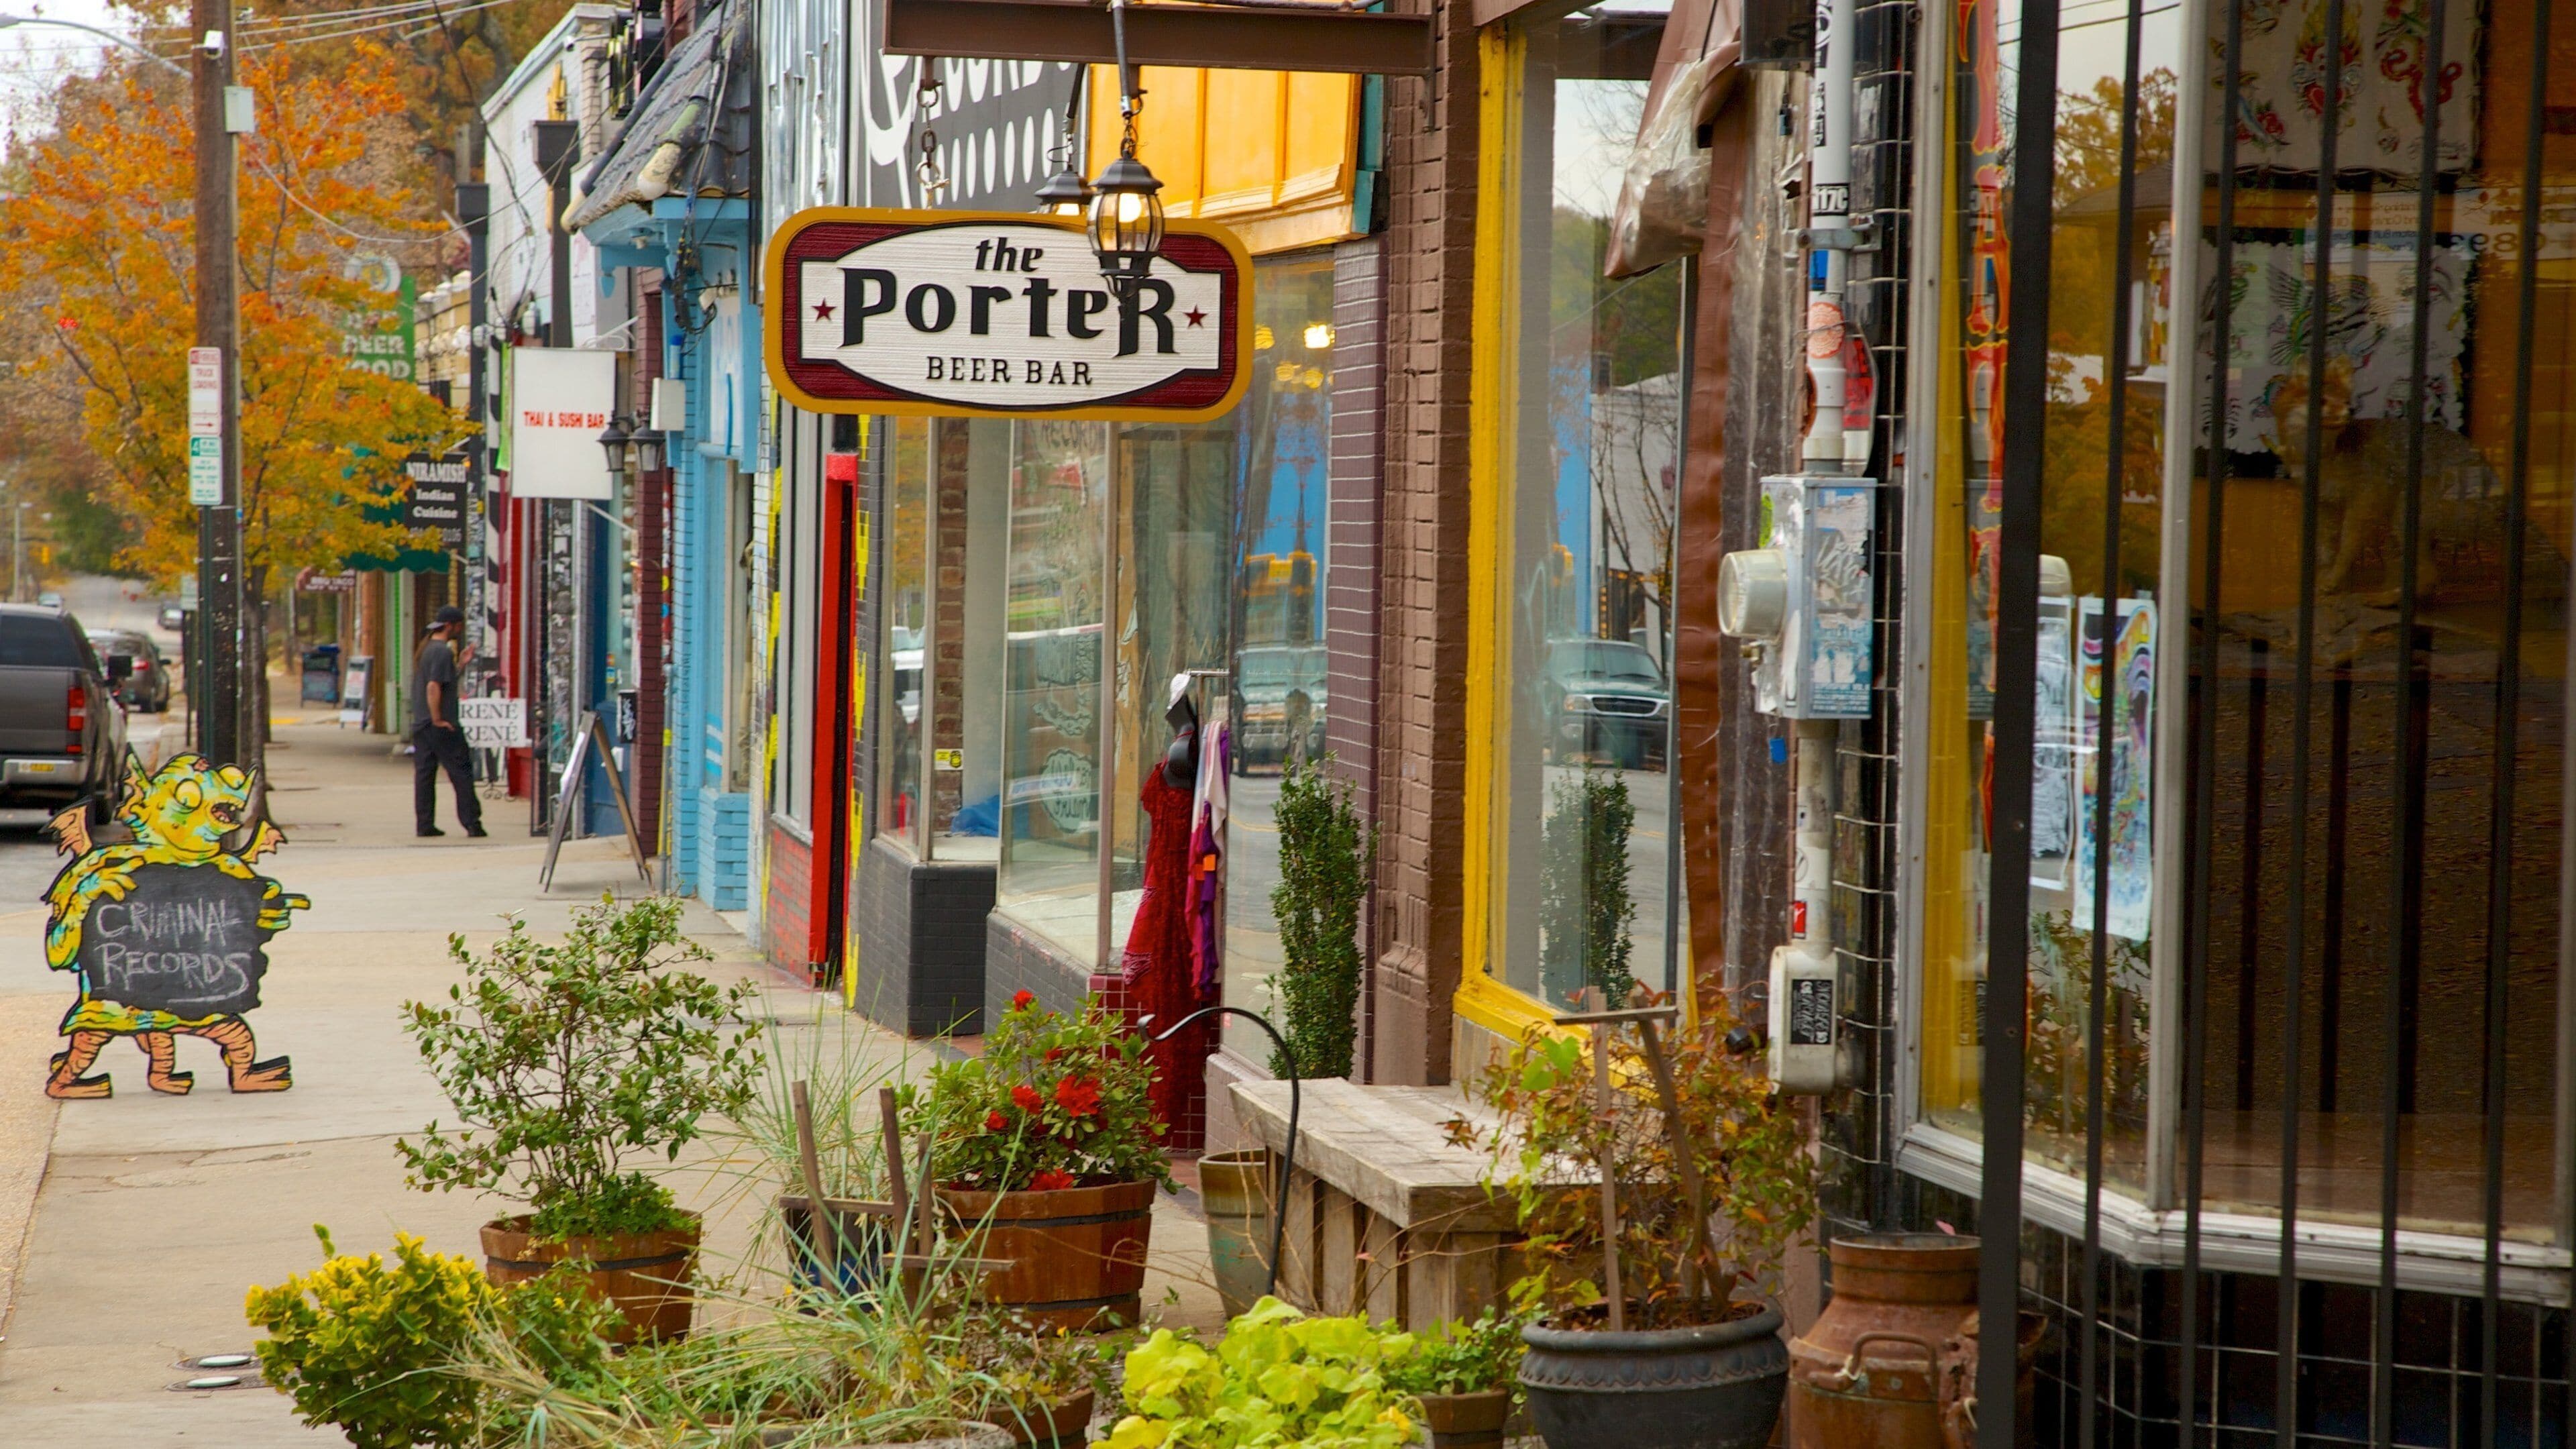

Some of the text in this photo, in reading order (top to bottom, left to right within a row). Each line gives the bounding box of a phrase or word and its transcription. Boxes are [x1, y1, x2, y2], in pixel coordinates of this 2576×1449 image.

[975, 237, 1042, 272] the
[926, 356, 1093, 385] BEER BAR
[523, 411, 604, 428] THAI & SUSHI BAR
[407, 462, 467, 483] NIRAMISH
[416, 488, 456, 502] Indian
[412, 505, 459, 519] Cuisine
[461, 699, 519, 719] RENÉ
[96, 898, 244, 949] CRIMINAL
[94, 941, 253, 1003] RECORDS
